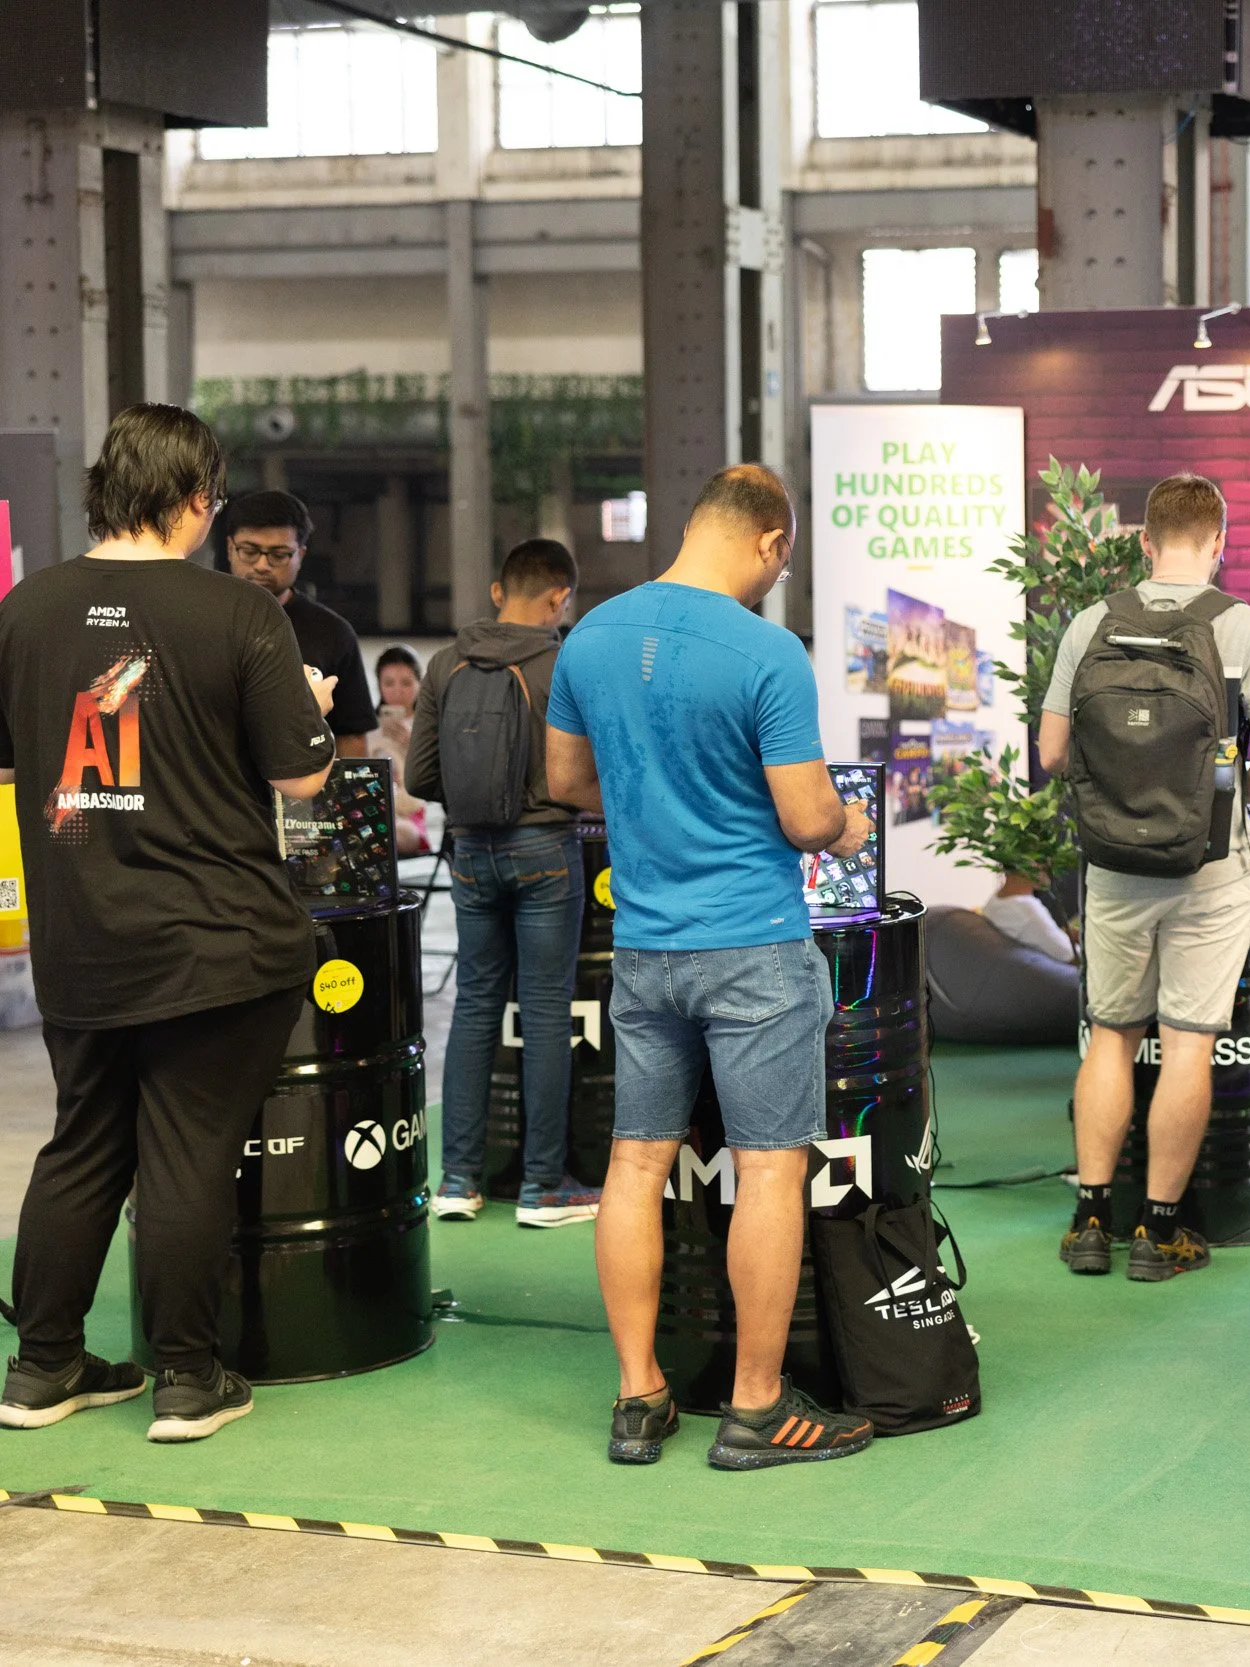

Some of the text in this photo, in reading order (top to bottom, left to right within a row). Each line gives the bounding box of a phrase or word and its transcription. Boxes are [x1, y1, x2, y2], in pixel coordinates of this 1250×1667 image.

[882, 441, 957, 465] PLAY
[835, 472, 1004, 496] HUNDREDS
[831, 504, 1006, 533] OF QUALITY
[867, 535, 974, 560] GAMES
[88, 606, 117, 617] AMD
[86, 618, 119, 627] RYZEN
[62, 691, 141, 787] AI
[57, 792, 145, 811] AMBASSADOR
[319, 976, 356, 992] $40 off
[267, 1136, 306, 1155] OF
[1152, 1205, 1178, 1216] RU
